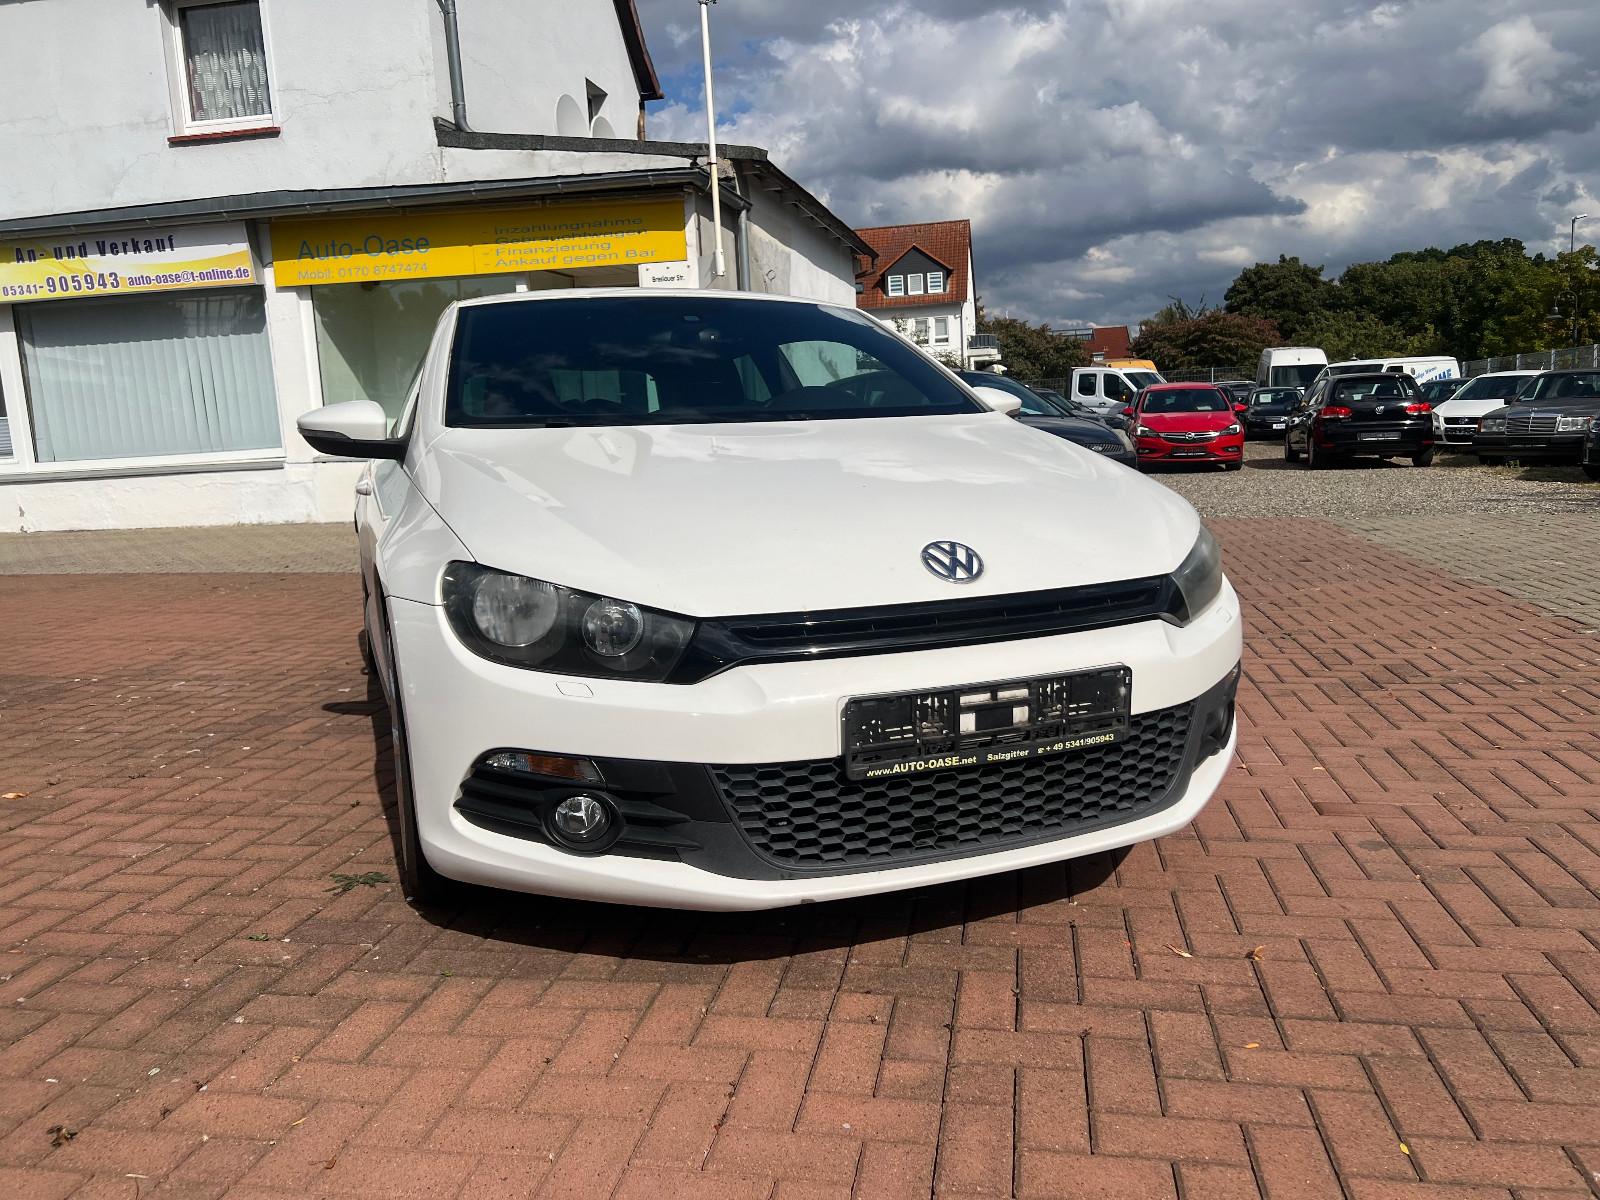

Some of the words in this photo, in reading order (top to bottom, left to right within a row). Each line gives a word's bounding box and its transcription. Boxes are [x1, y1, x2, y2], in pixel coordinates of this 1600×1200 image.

[15, 247, 45, 263] An-
[54, 242, 88, 261] und
[96, 234, 175, 257] Verkauf
[297, 234, 431, 261] Auto-Oase
[494, 255, 558, 268] Ankauf
[562, 252, 619, 265] gegen
[625, 248, 656, 259] Bar
[495, 241, 612, 257] Finanzierung
[2, 272, 121, 297] 05341-905943
[127, 266, 250, 287] auto-oase@t-online.de
[297, 269, 335, 281] Mobil:
[338, 265, 369, 278] 0170
[866, 755, 977, 777] www.AUTO-OASE.net
[986, 748, 1030, 762] Salzgitter
[1052, 742, 1064, 751] 49
[1065, 733, 1115, 749] 5341/905943
